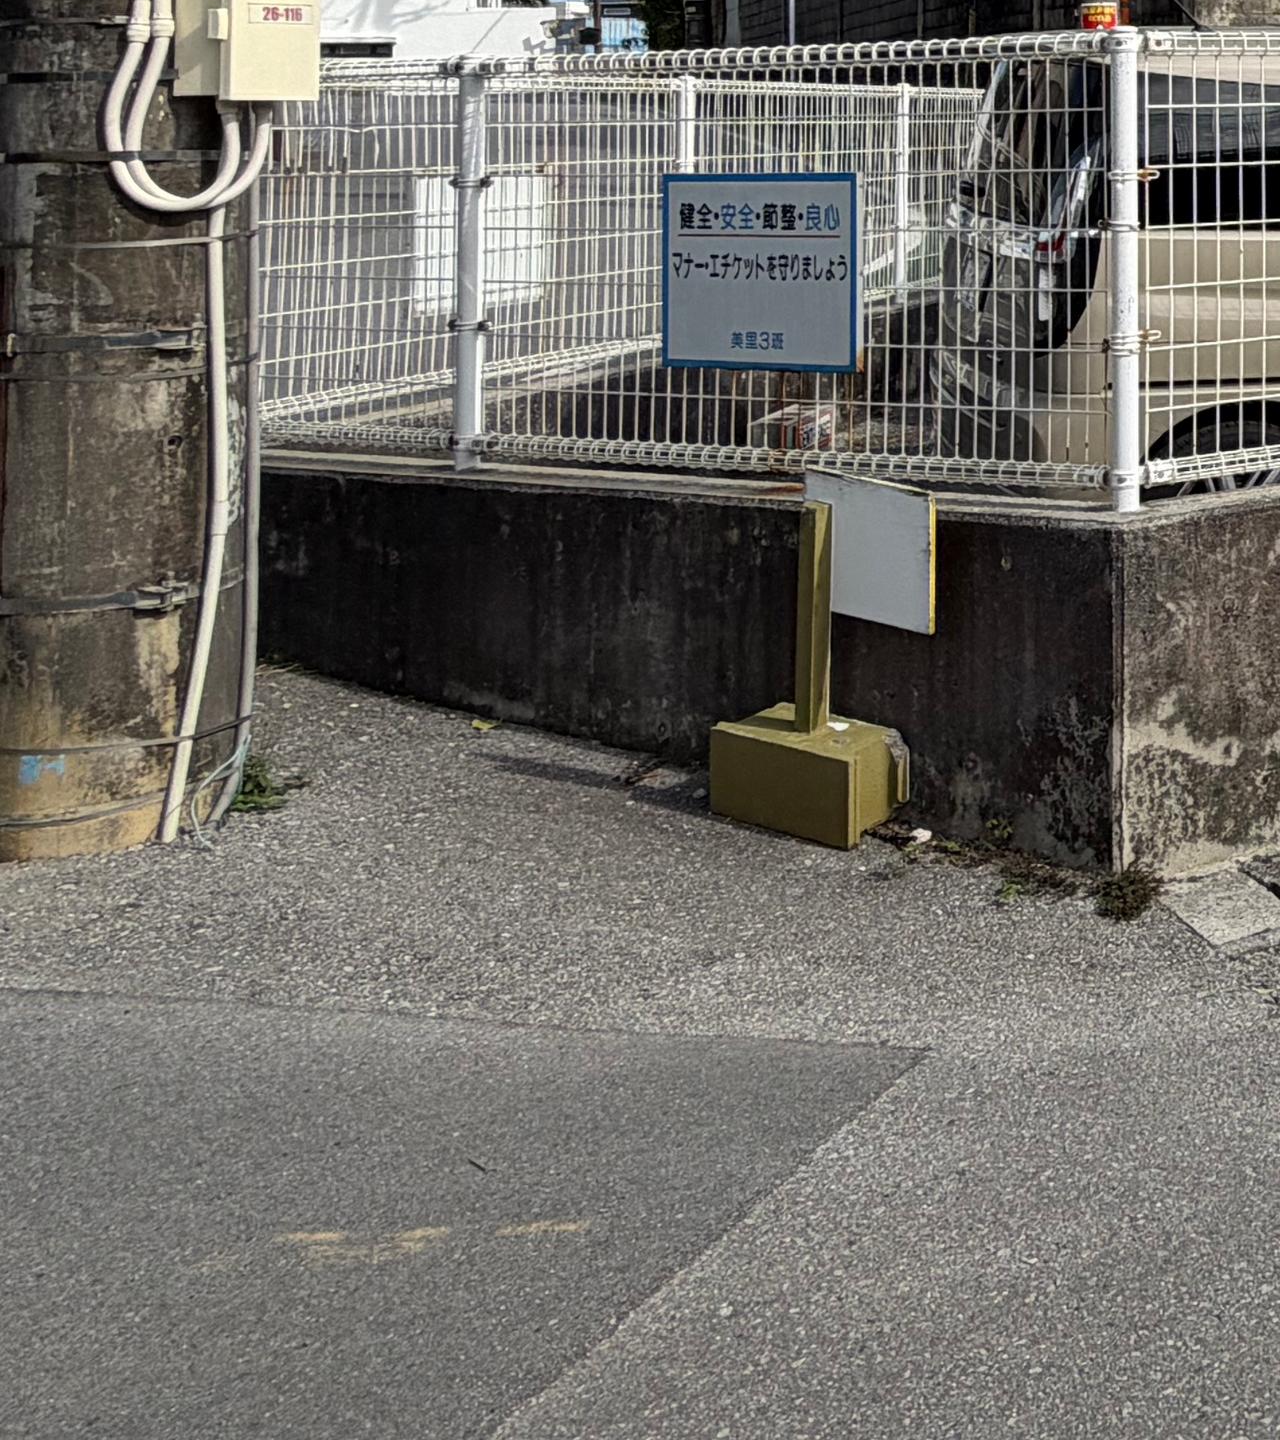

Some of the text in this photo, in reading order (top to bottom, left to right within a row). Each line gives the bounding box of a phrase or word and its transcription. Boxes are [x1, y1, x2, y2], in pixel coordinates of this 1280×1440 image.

[262, 6, 303, 22] 26-116
[731, 331, 784, 350] 美里3班
